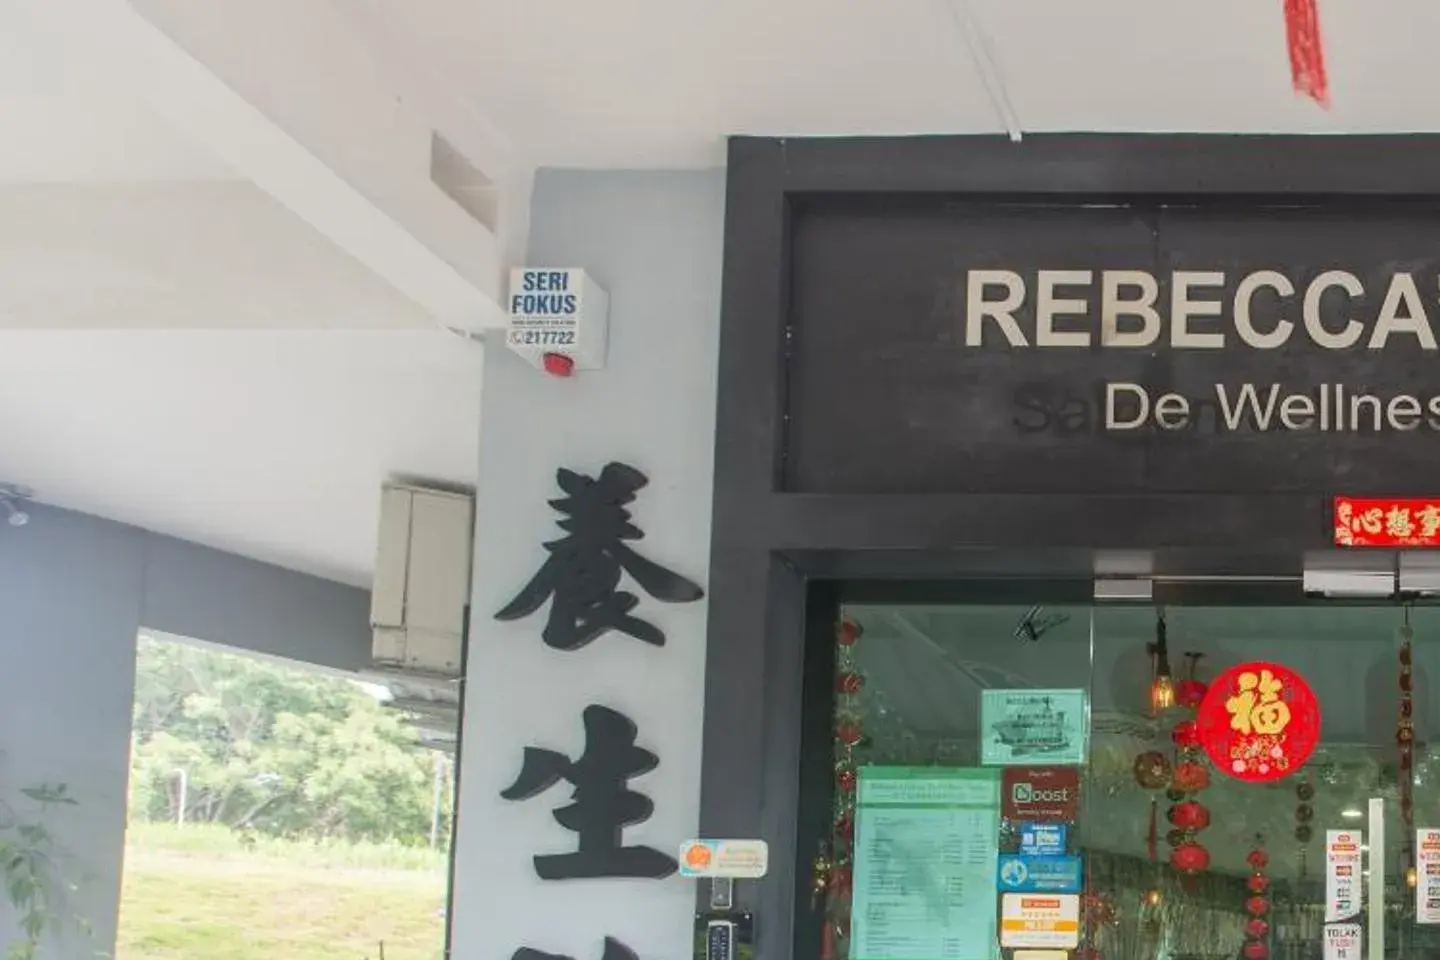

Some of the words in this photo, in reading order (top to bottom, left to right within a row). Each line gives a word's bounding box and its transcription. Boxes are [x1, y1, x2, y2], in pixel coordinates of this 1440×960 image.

[523, 271, 568, 291] SERI
[511, 294, 577, 315] FOKUS
[525, 330, 576, 345] 217722
[1106, 382, 1190, 432] De
[1225, 669, 1292, 735] 福
